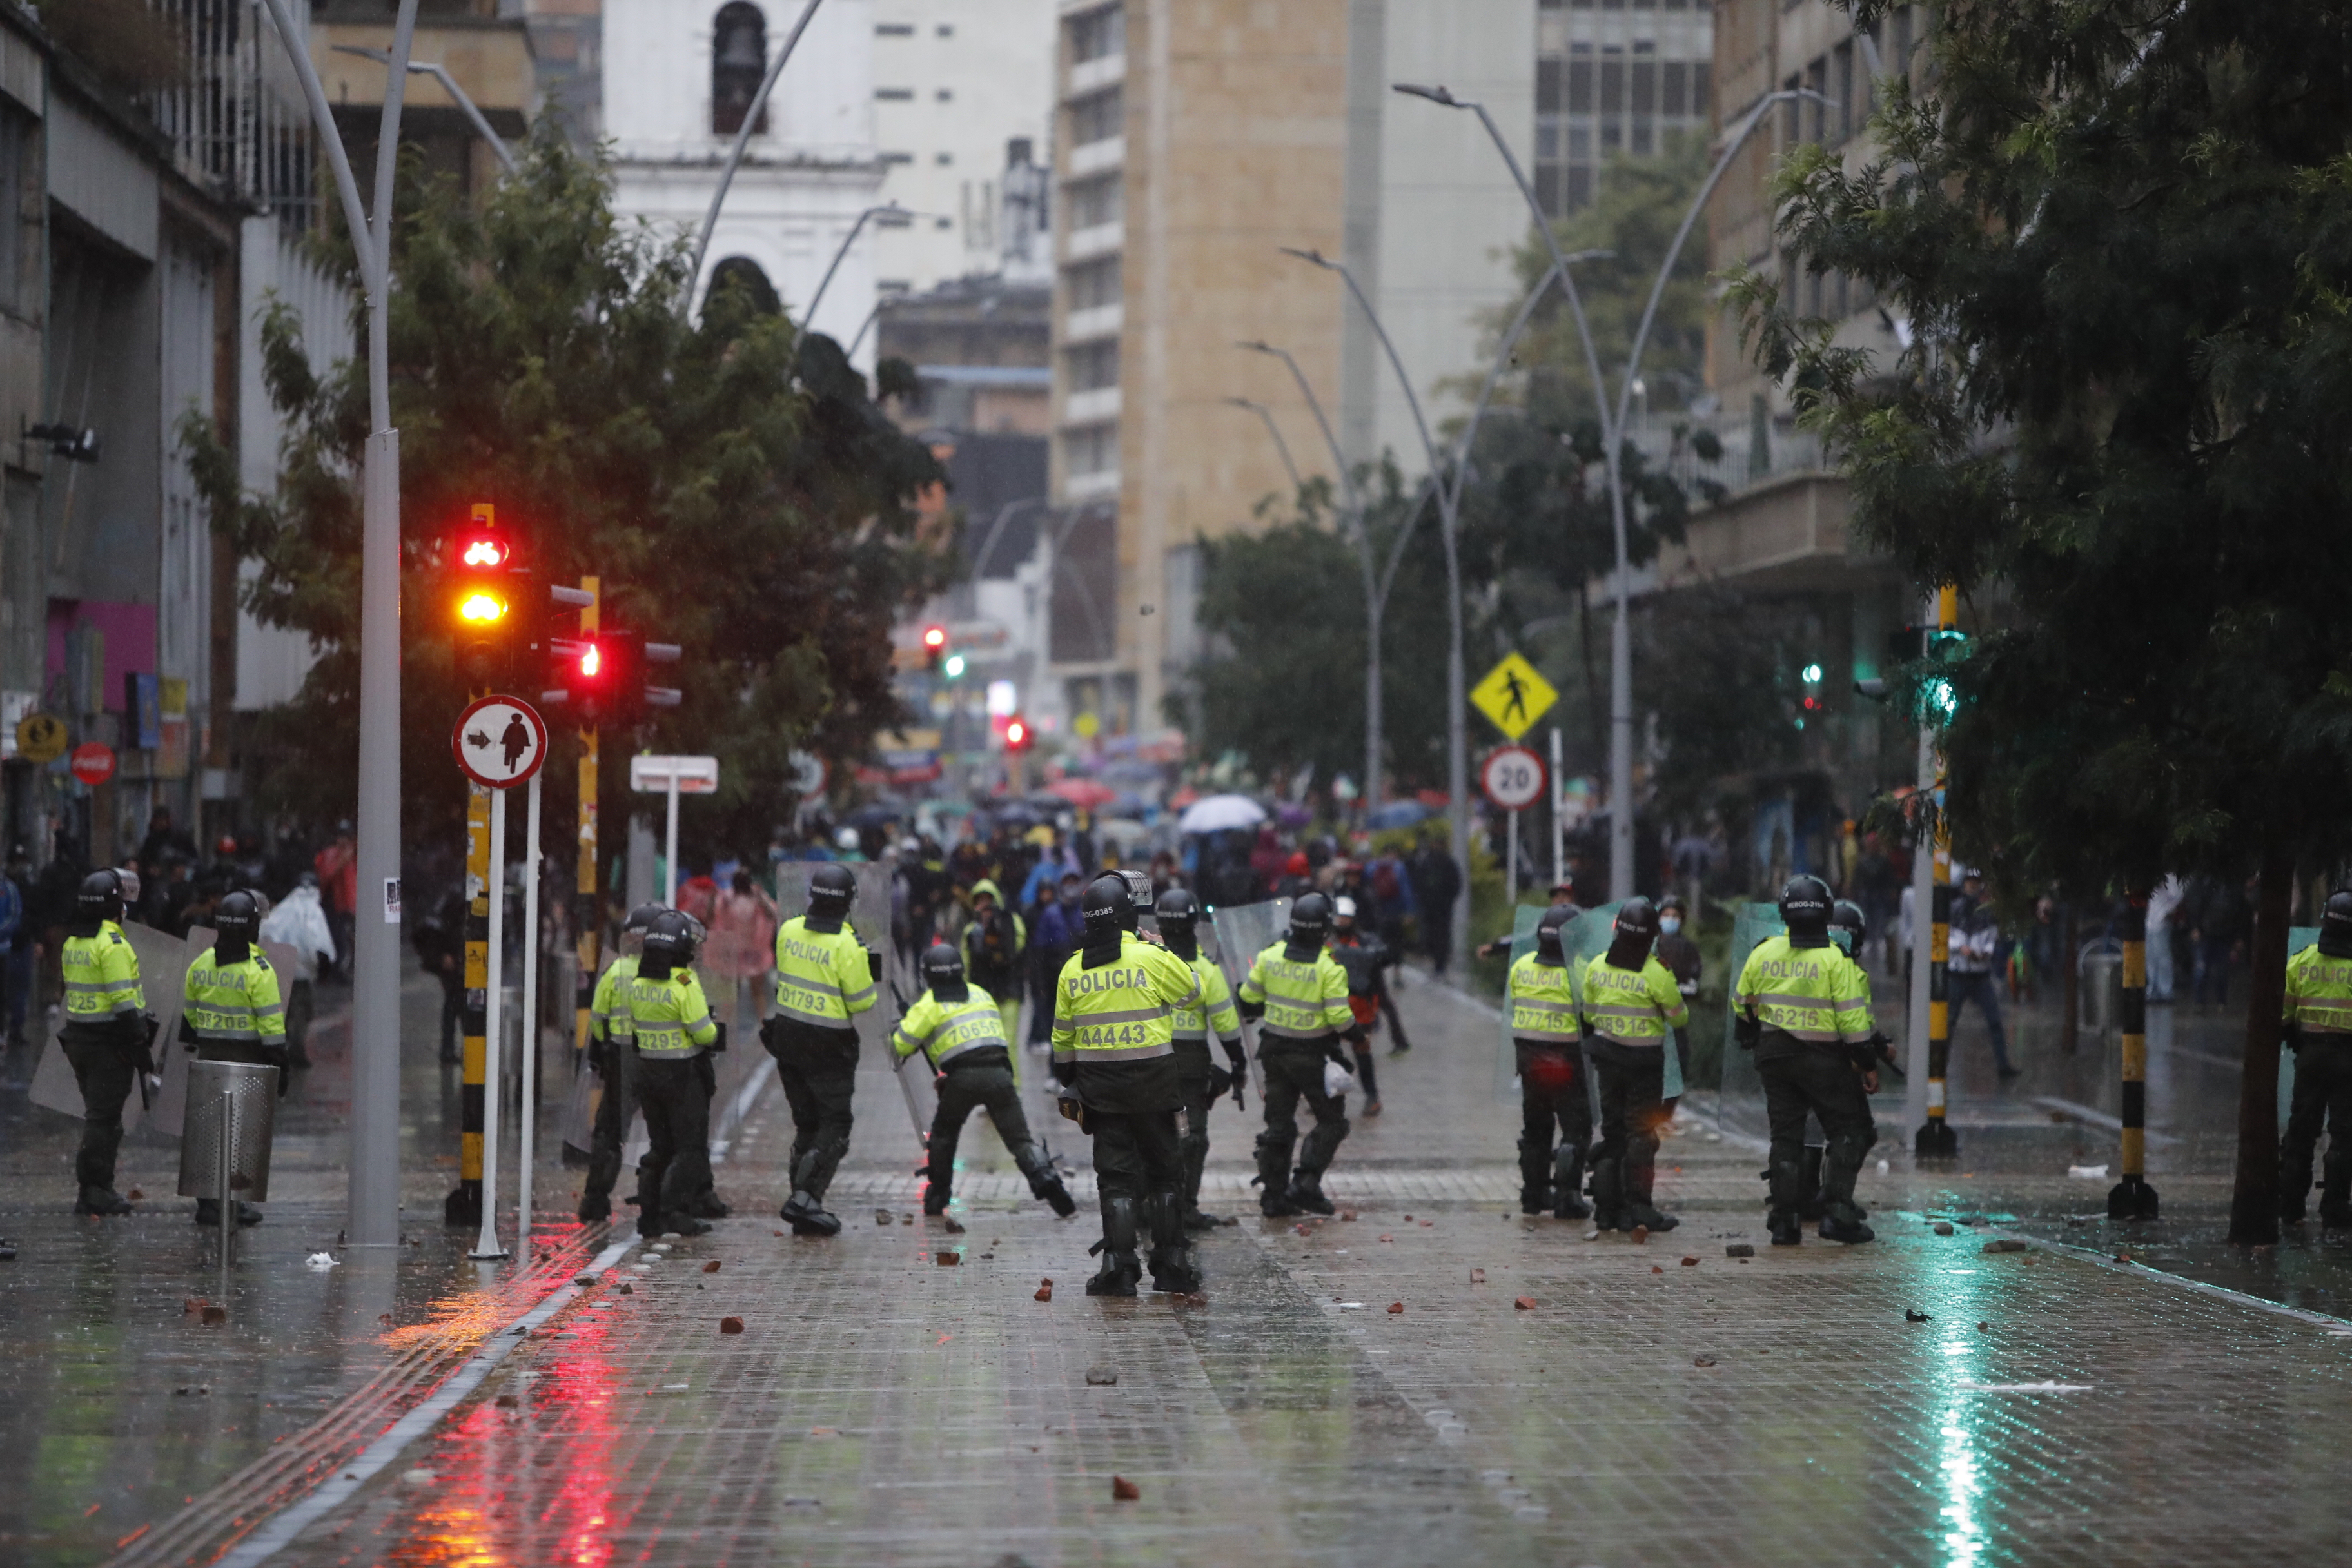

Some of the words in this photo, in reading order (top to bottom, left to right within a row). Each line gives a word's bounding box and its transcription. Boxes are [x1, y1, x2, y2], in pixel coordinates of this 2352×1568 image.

[65, 950, 91, 966] OLICIA
[784, 939, 831, 966] POLICIA
[193, 970, 246, 991] POLICIA
[1265, 960, 1317, 983] POLICIA
[1516, 968, 1562, 988] POLICIA
[1761, 961, 1819, 979] POLICIA
[2298, 965, 2352, 985] POLICI
[1068, 968, 1148, 997] POLICIA
[1591, 970, 1647, 993] POLICIA
[1081, 1024, 1146, 1047] 44443
